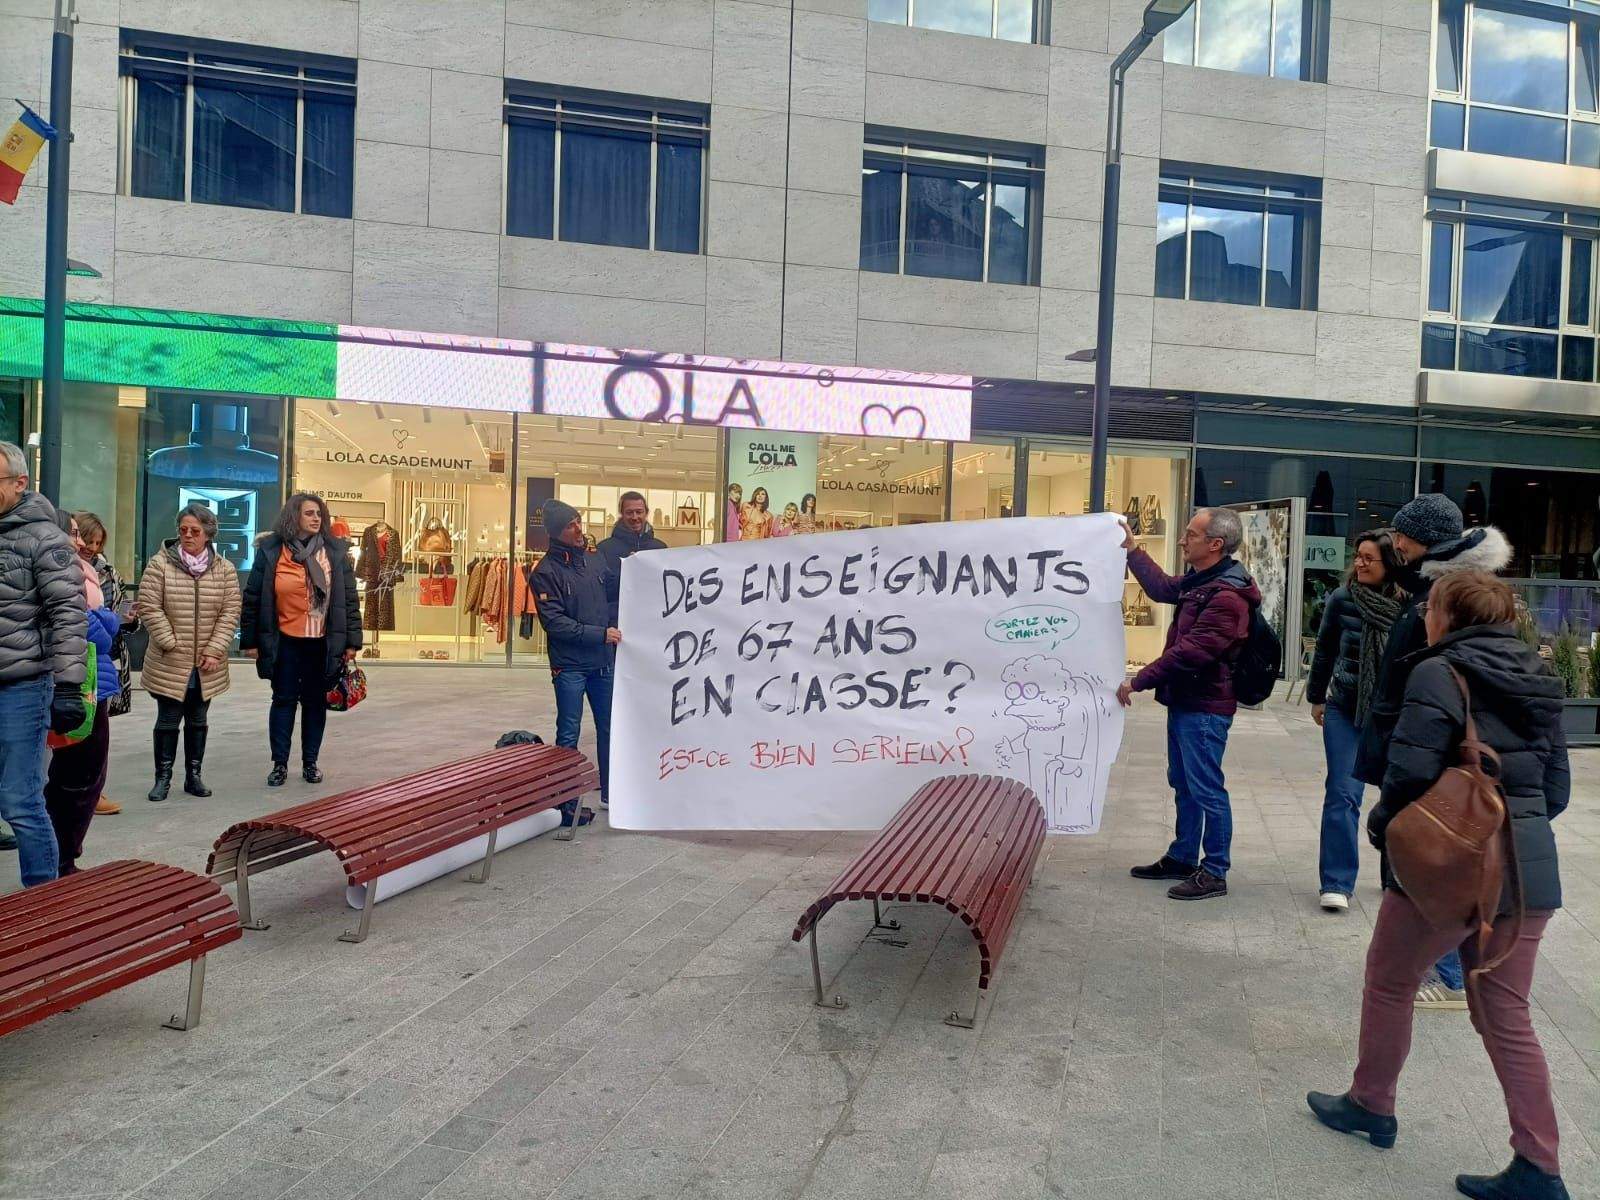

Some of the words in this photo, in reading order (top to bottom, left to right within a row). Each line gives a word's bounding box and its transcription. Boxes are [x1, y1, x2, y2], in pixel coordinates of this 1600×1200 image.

[749, 443, 778, 452] CALL
[780, 445, 796, 453] ME
[326, 451, 365, 464] LOLA
[369, 454, 473, 470] CASADEMUNT
[748, 452, 798, 467] LOLA
[327, 491, 363, 500] D'AUTOR
[822, 480, 854, 491] LOLA
[857, 482, 942, 496] CASADEMUNT
[681, 510, 697, 526] M
[662, 567, 724, 618] DES
[664, 628, 718, 671] DE
[737, 619, 794, 663] 67
[813, 614, 917, 659] ANS
[671, 674, 735, 726] EN
[658, 748, 731, 780] EST-CE
